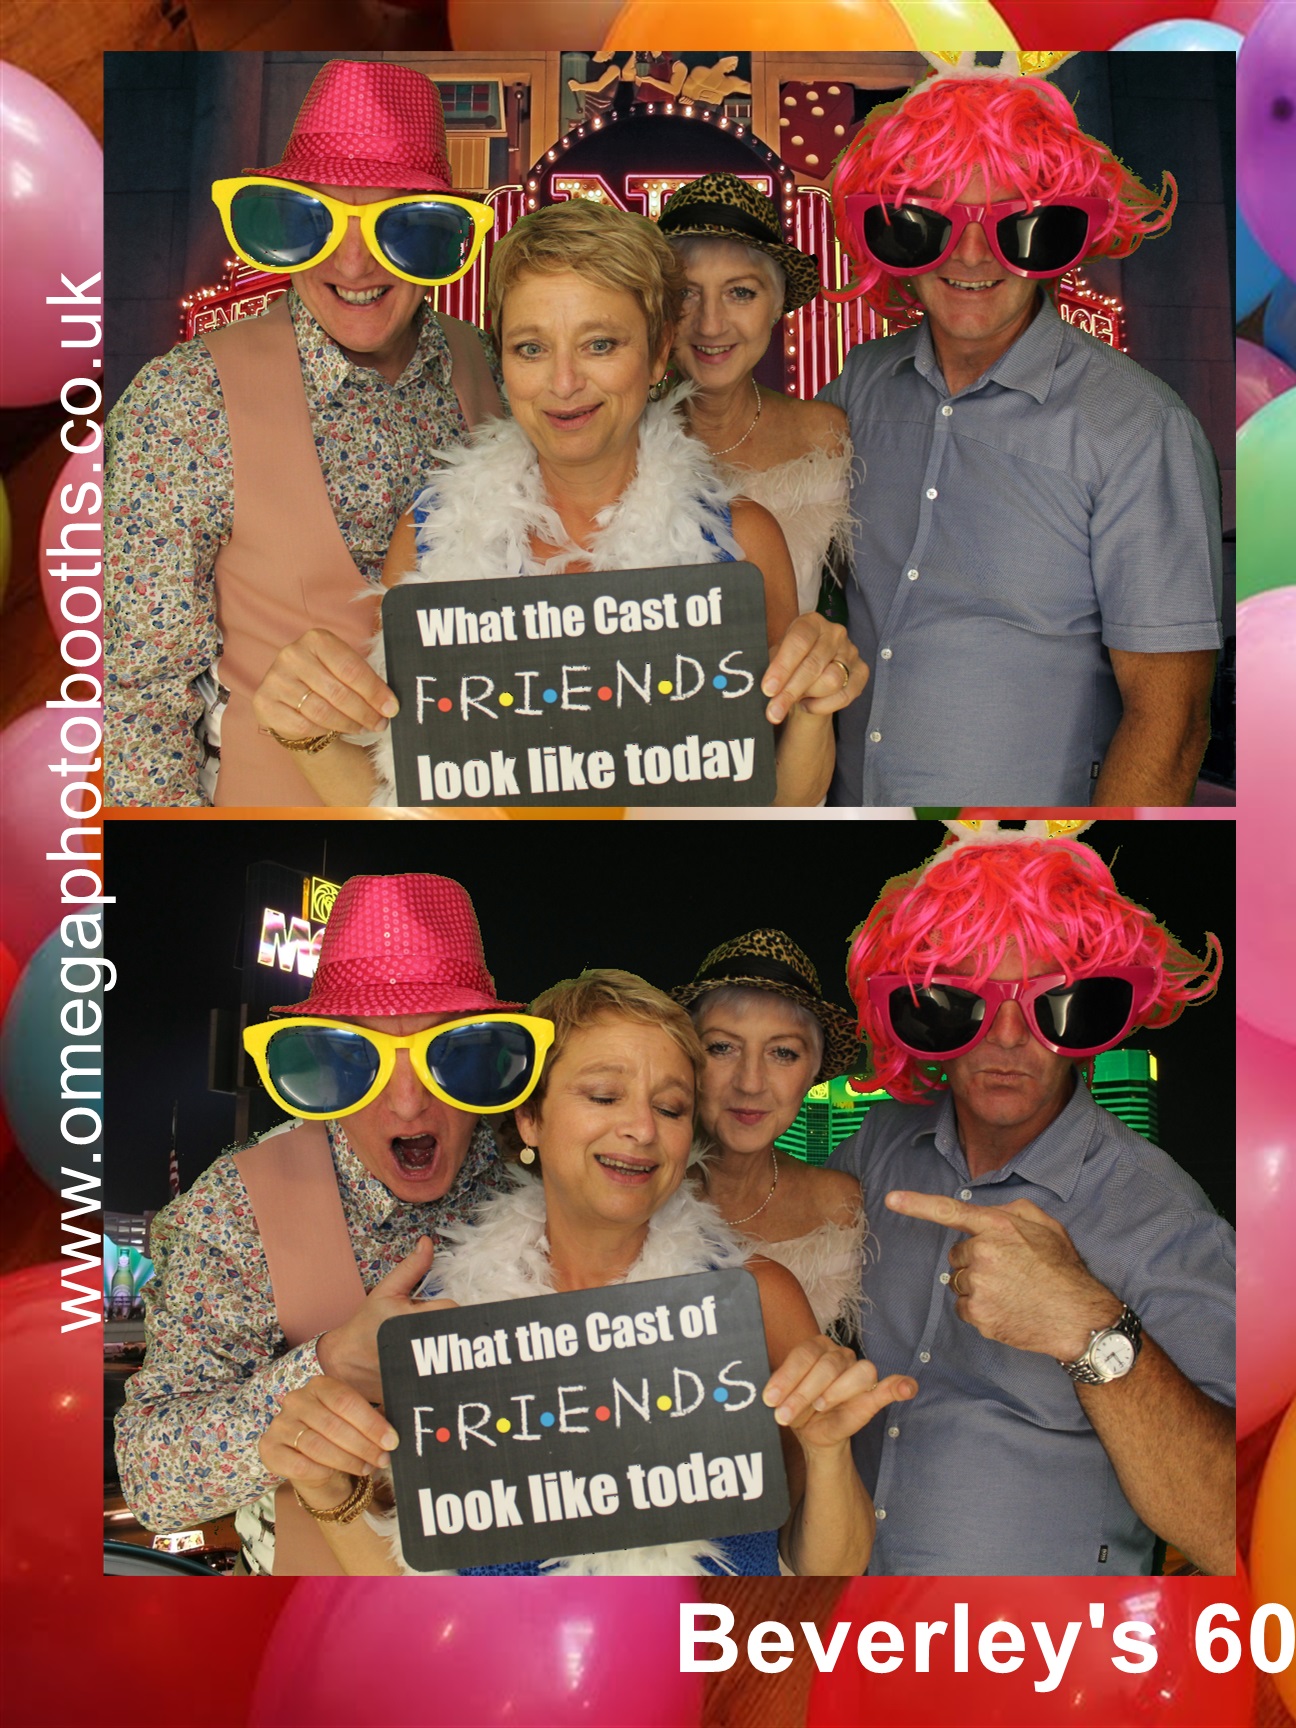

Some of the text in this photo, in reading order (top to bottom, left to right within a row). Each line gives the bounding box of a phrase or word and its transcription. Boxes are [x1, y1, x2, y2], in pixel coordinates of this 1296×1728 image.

[415, 586, 722, 647] What the Cast of
[416, 734, 755, 801] look like today
[410, 1294, 718, 1377] What the Cast of
[417, 1451, 764, 1537] look like today
